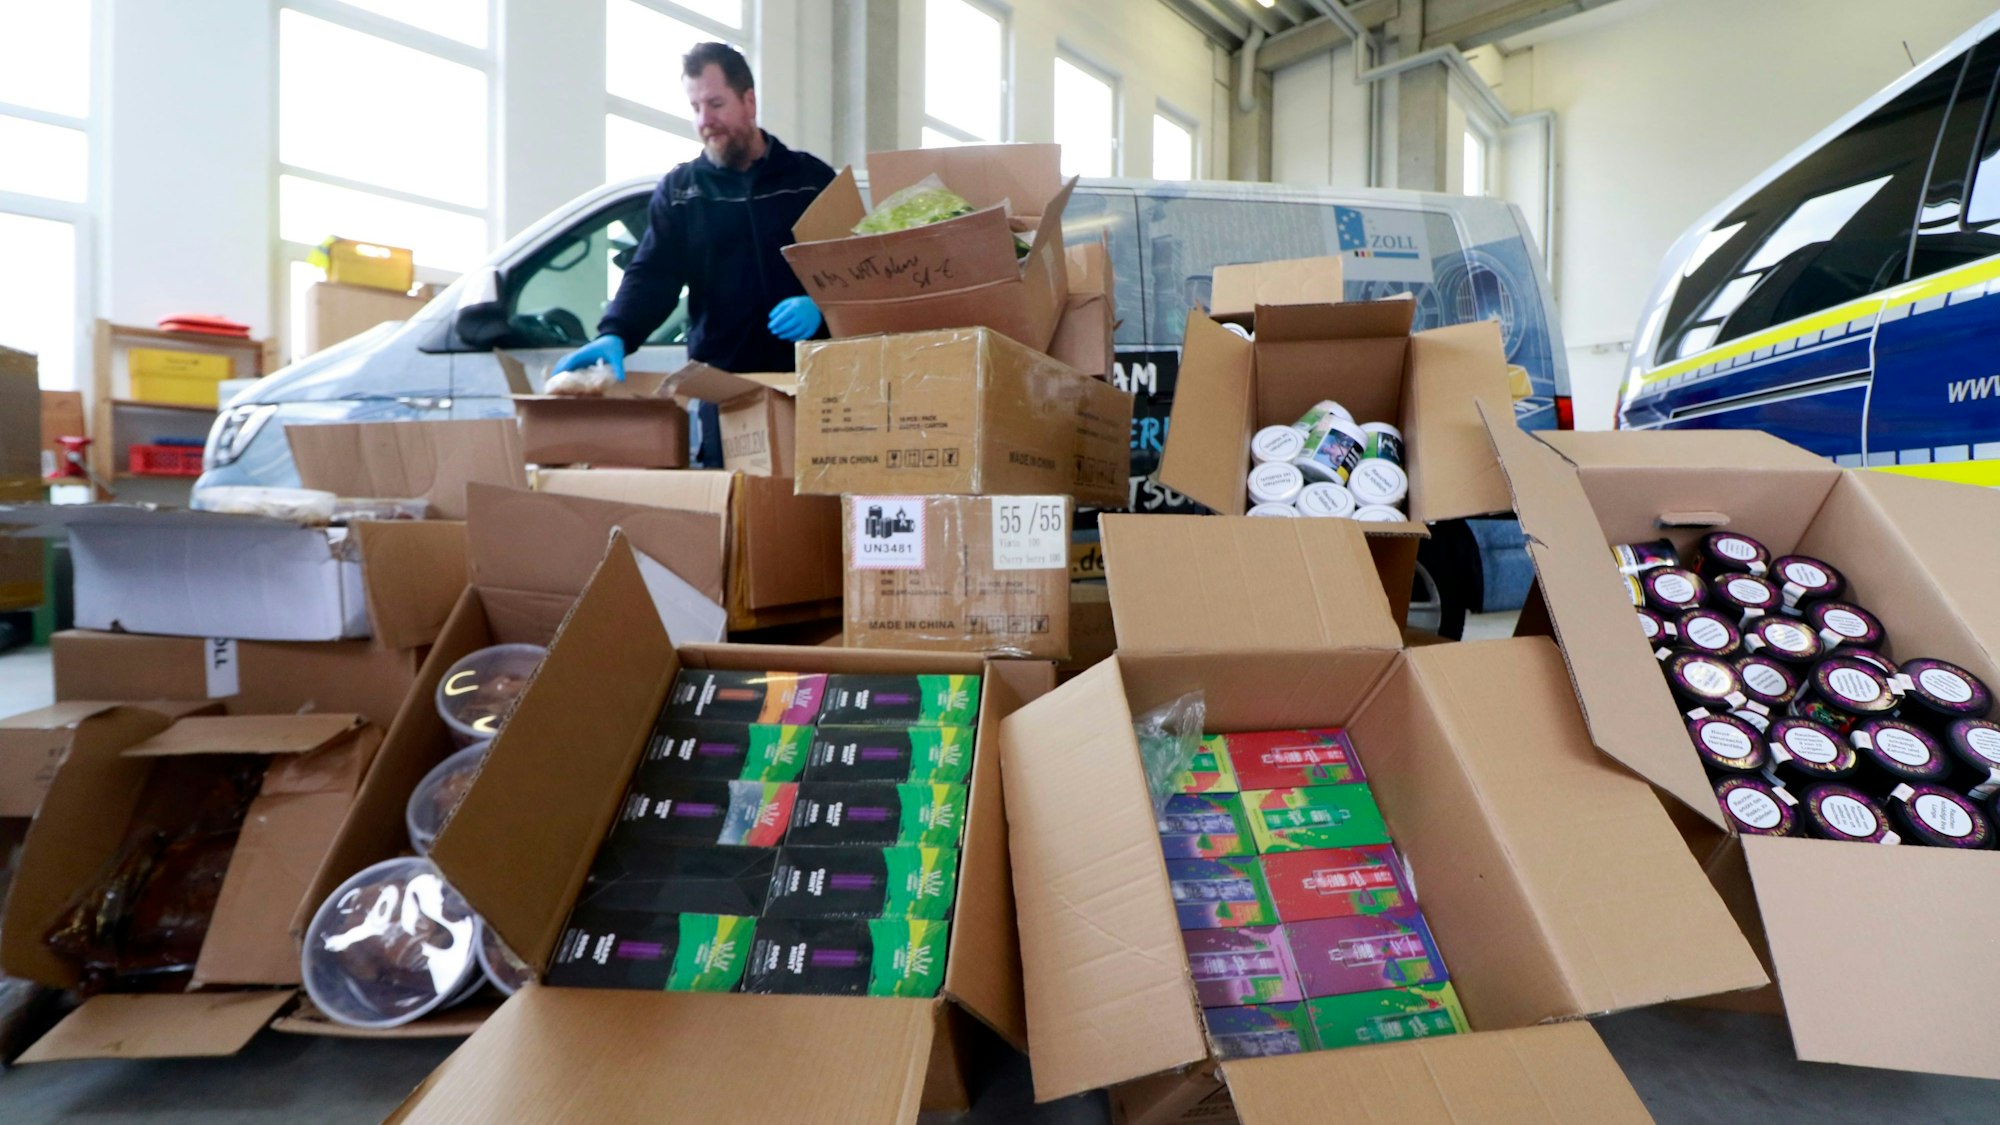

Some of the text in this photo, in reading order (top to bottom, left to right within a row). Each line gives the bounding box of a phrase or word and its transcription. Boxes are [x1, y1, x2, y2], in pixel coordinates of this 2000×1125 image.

[1370, 234, 1418, 249] ZOLL
[1130, 416, 1170, 453] ER
[812, 457, 837, 465] MADE
[850, 456, 879, 464] CHINA
[1000, 505, 1021, 534] 55
[864, 543, 912, 553] UN3481
[869, 620, 955, 630] MADE IN CHINA
[826, 804, 835, 824] MINT
[832, 802, 843, 827] GRAPE
[808, 871, 818, 893] MINT
[814, 868, 826, 896] GRAPE
[787, 945, 798, 971] MINT
[793, 942, 807, 974] GRAPE
